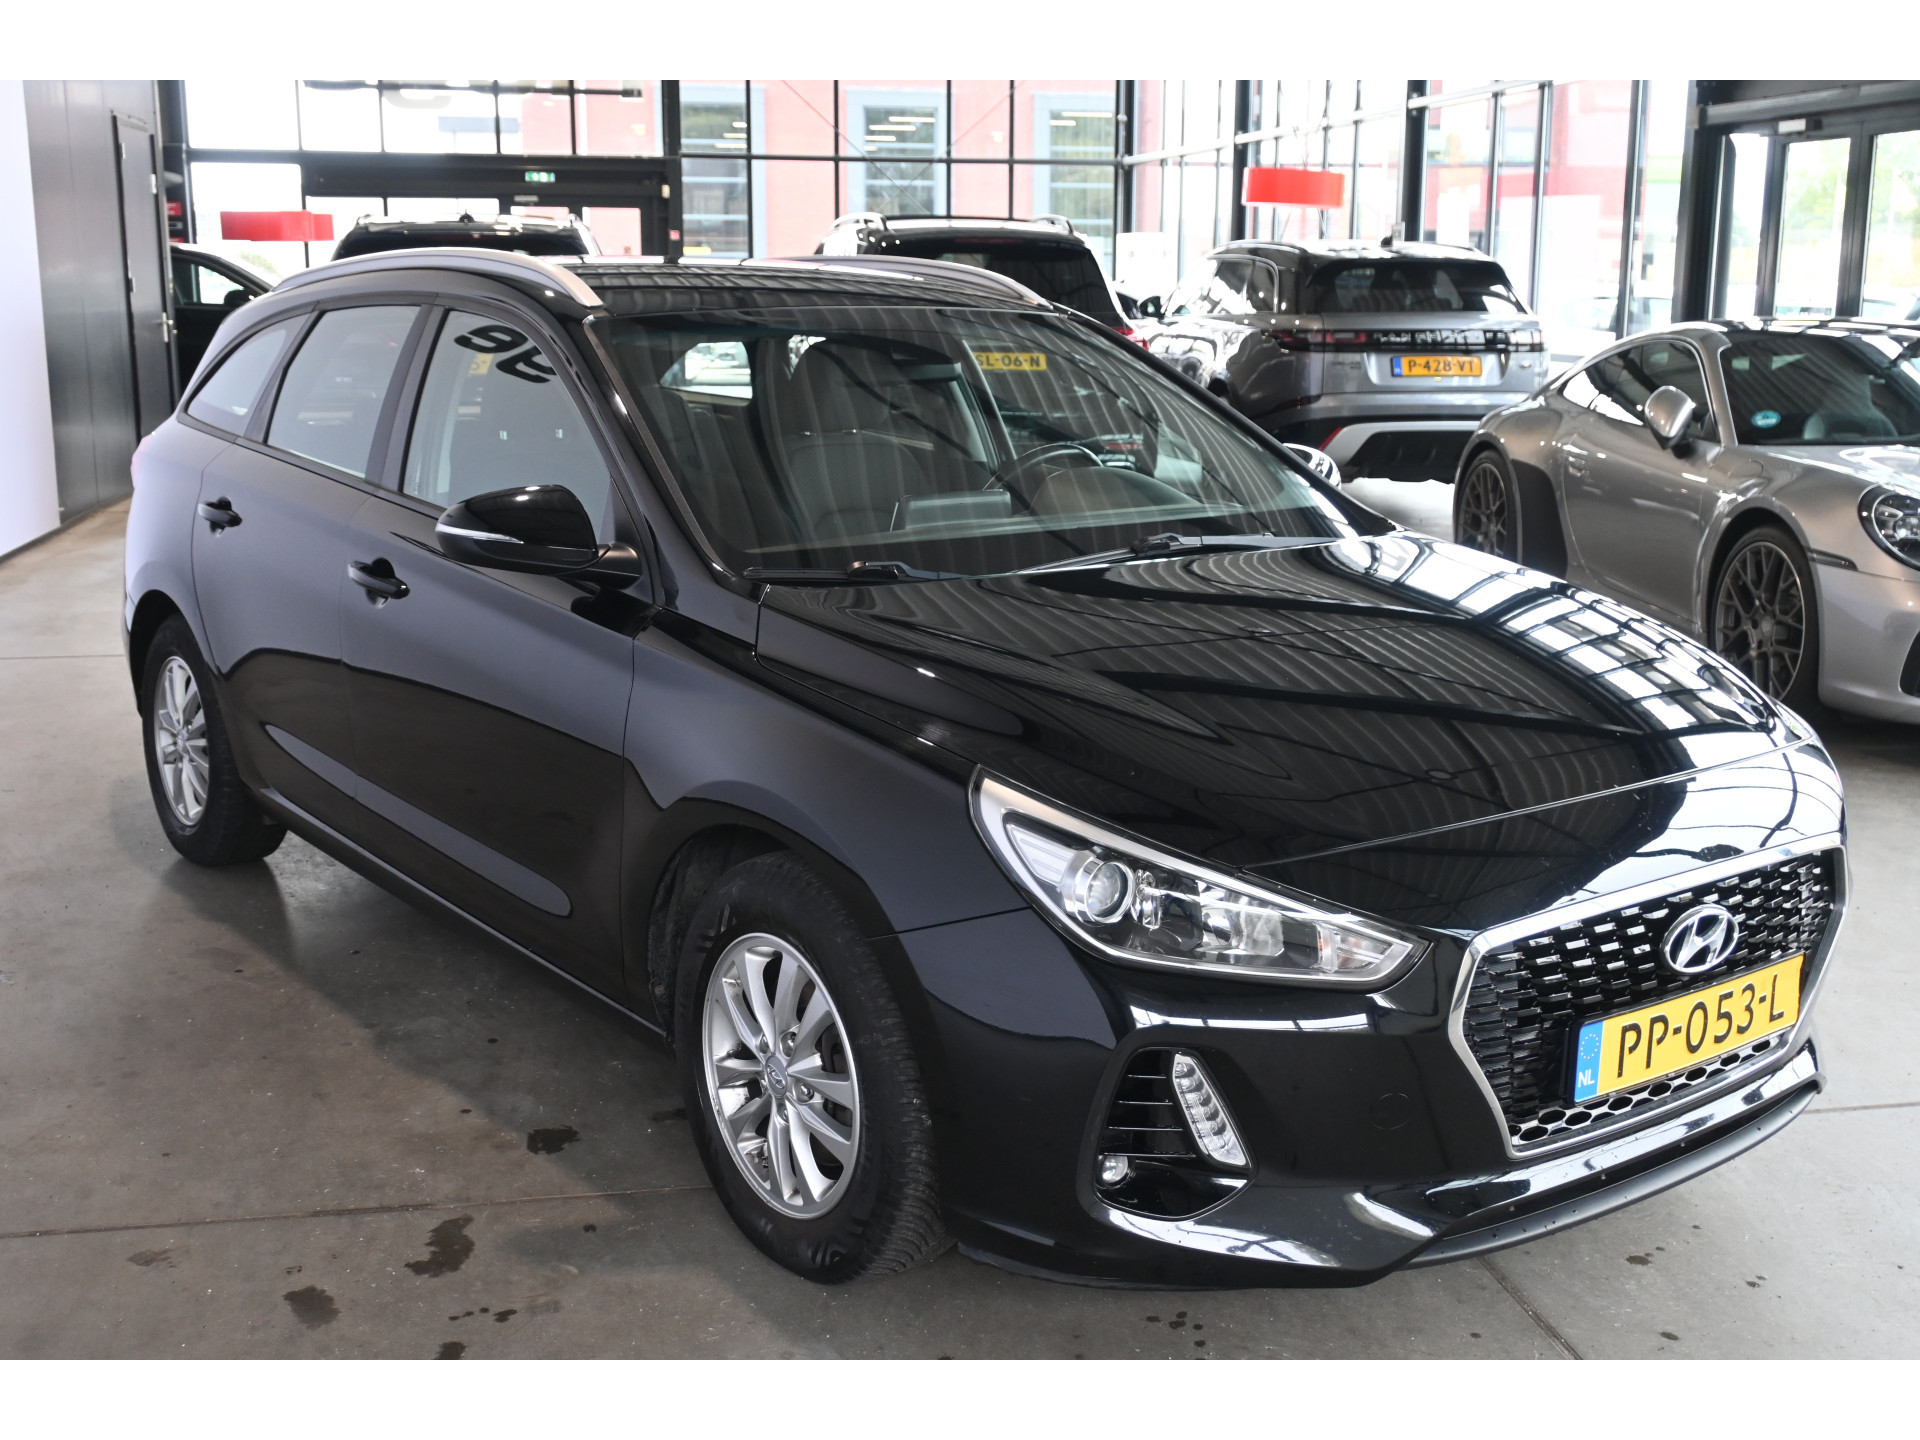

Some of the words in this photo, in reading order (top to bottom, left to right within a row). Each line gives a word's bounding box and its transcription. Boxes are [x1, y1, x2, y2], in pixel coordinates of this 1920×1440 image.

[1408, 359, 1474, 372] P-428-VT
[1617, 973, 1784, 1078] PP-053-L
[1578, 1069, 1595, 1087] NL
